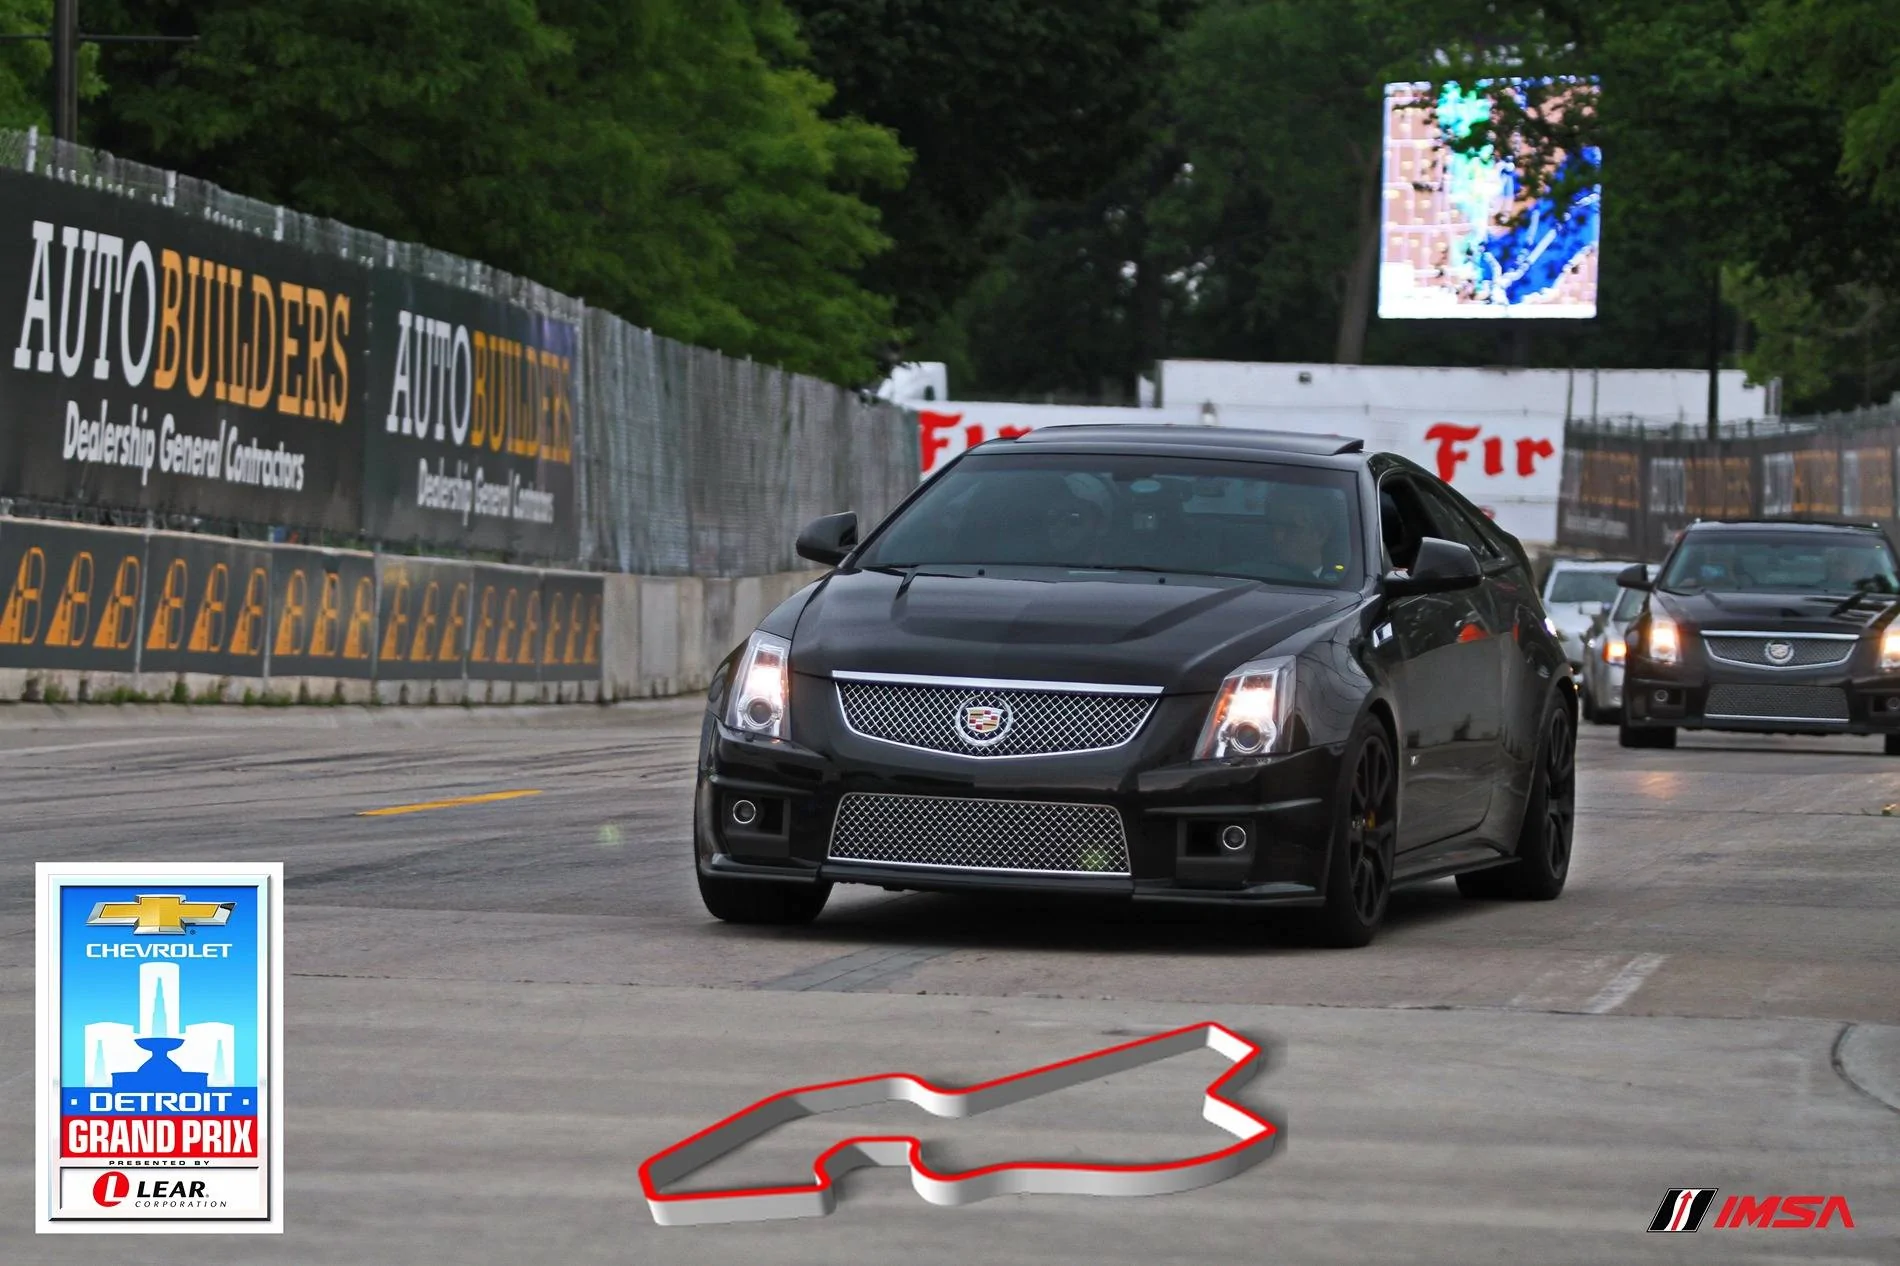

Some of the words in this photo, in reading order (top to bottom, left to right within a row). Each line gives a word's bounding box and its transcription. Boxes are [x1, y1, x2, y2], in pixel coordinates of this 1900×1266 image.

[13, 219, 350, 425] AUTOBUILDERS
[62, 399, 156, 486] Dealership
[159, 413, 226, 478] General
[225, 425, 305, 490] Contractors
